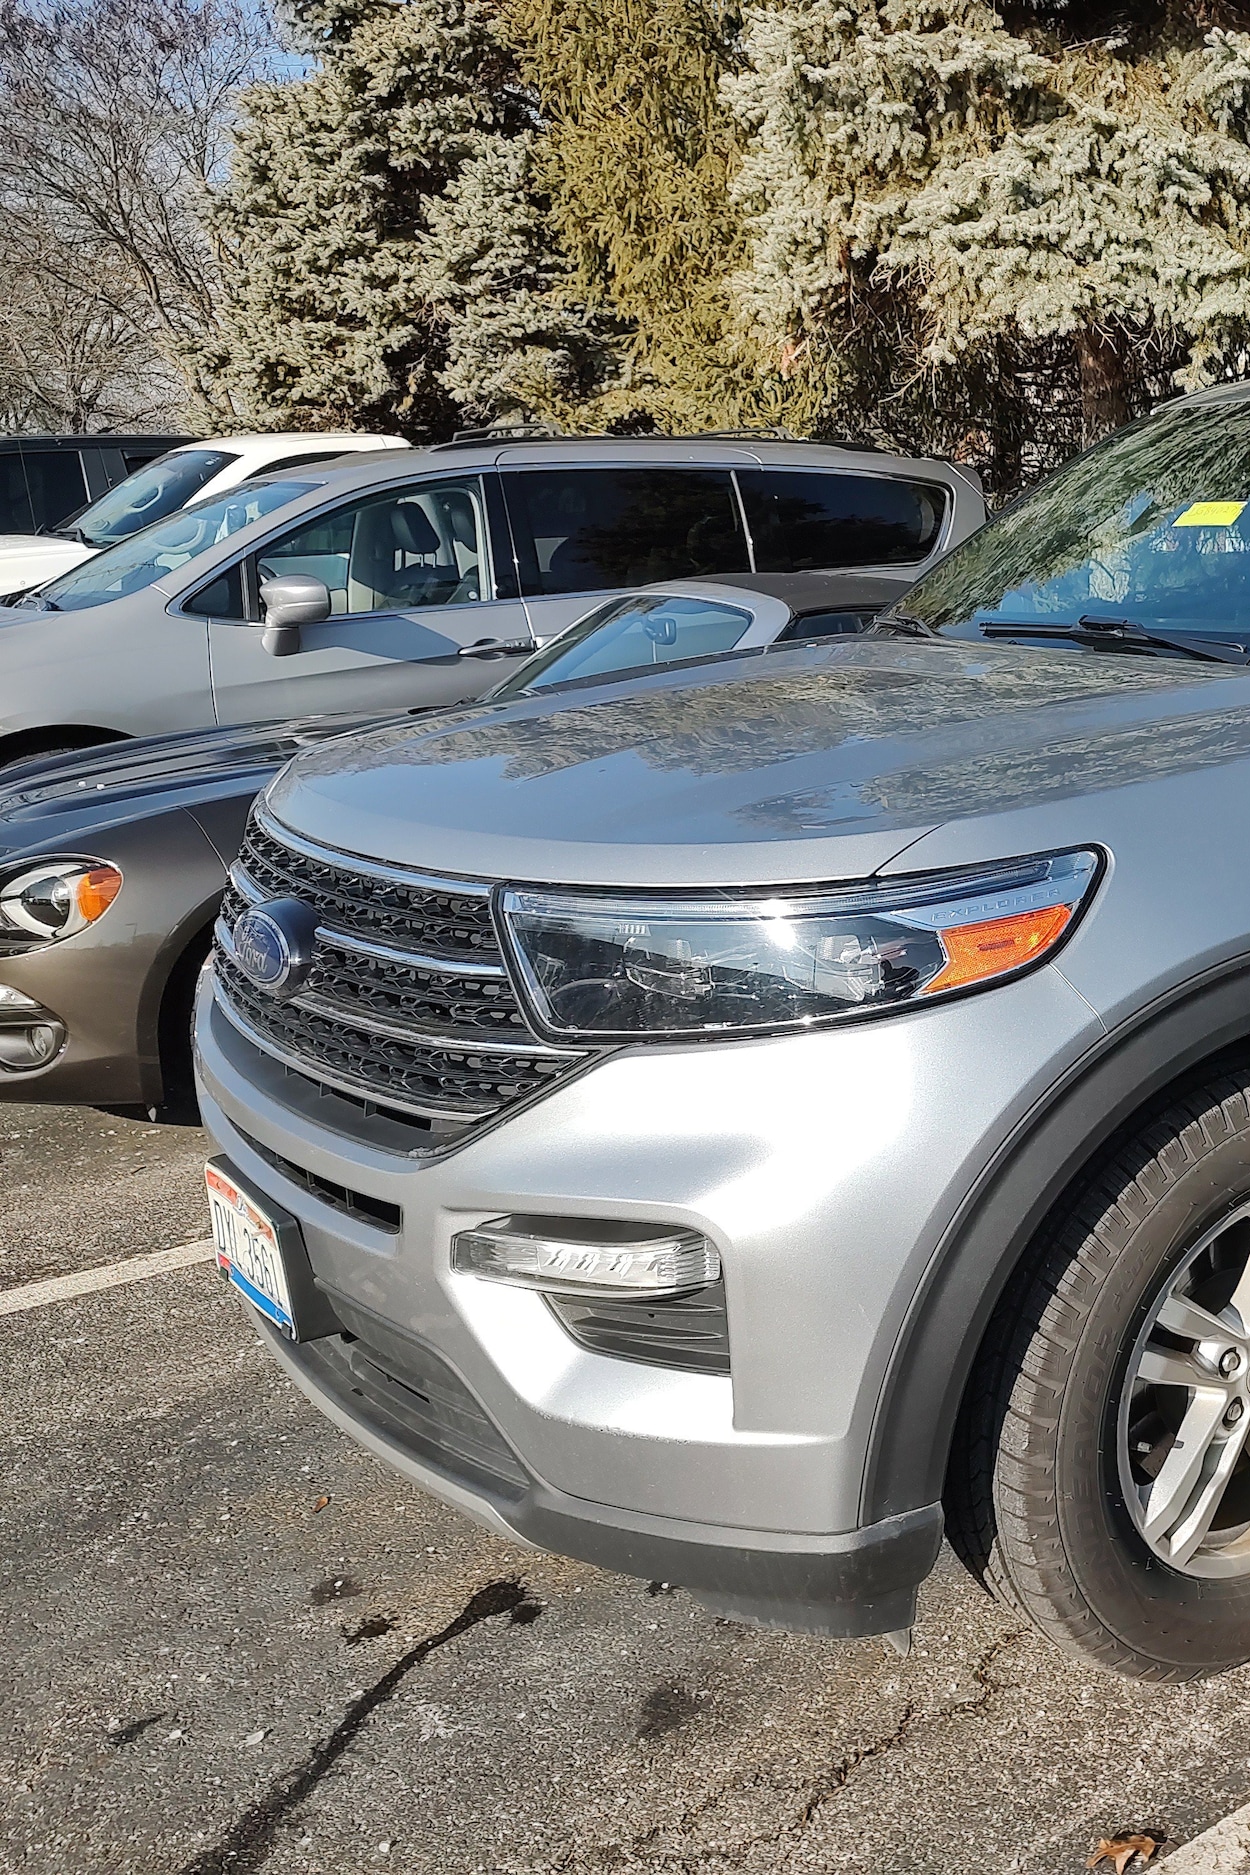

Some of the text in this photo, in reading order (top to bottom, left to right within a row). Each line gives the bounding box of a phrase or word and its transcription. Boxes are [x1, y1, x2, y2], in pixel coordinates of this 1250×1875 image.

[930, 887, 1062, 923] EXPLORER
[240, 924, 270, 975] Ford
[243, 1226, 285, 1309] 3561
